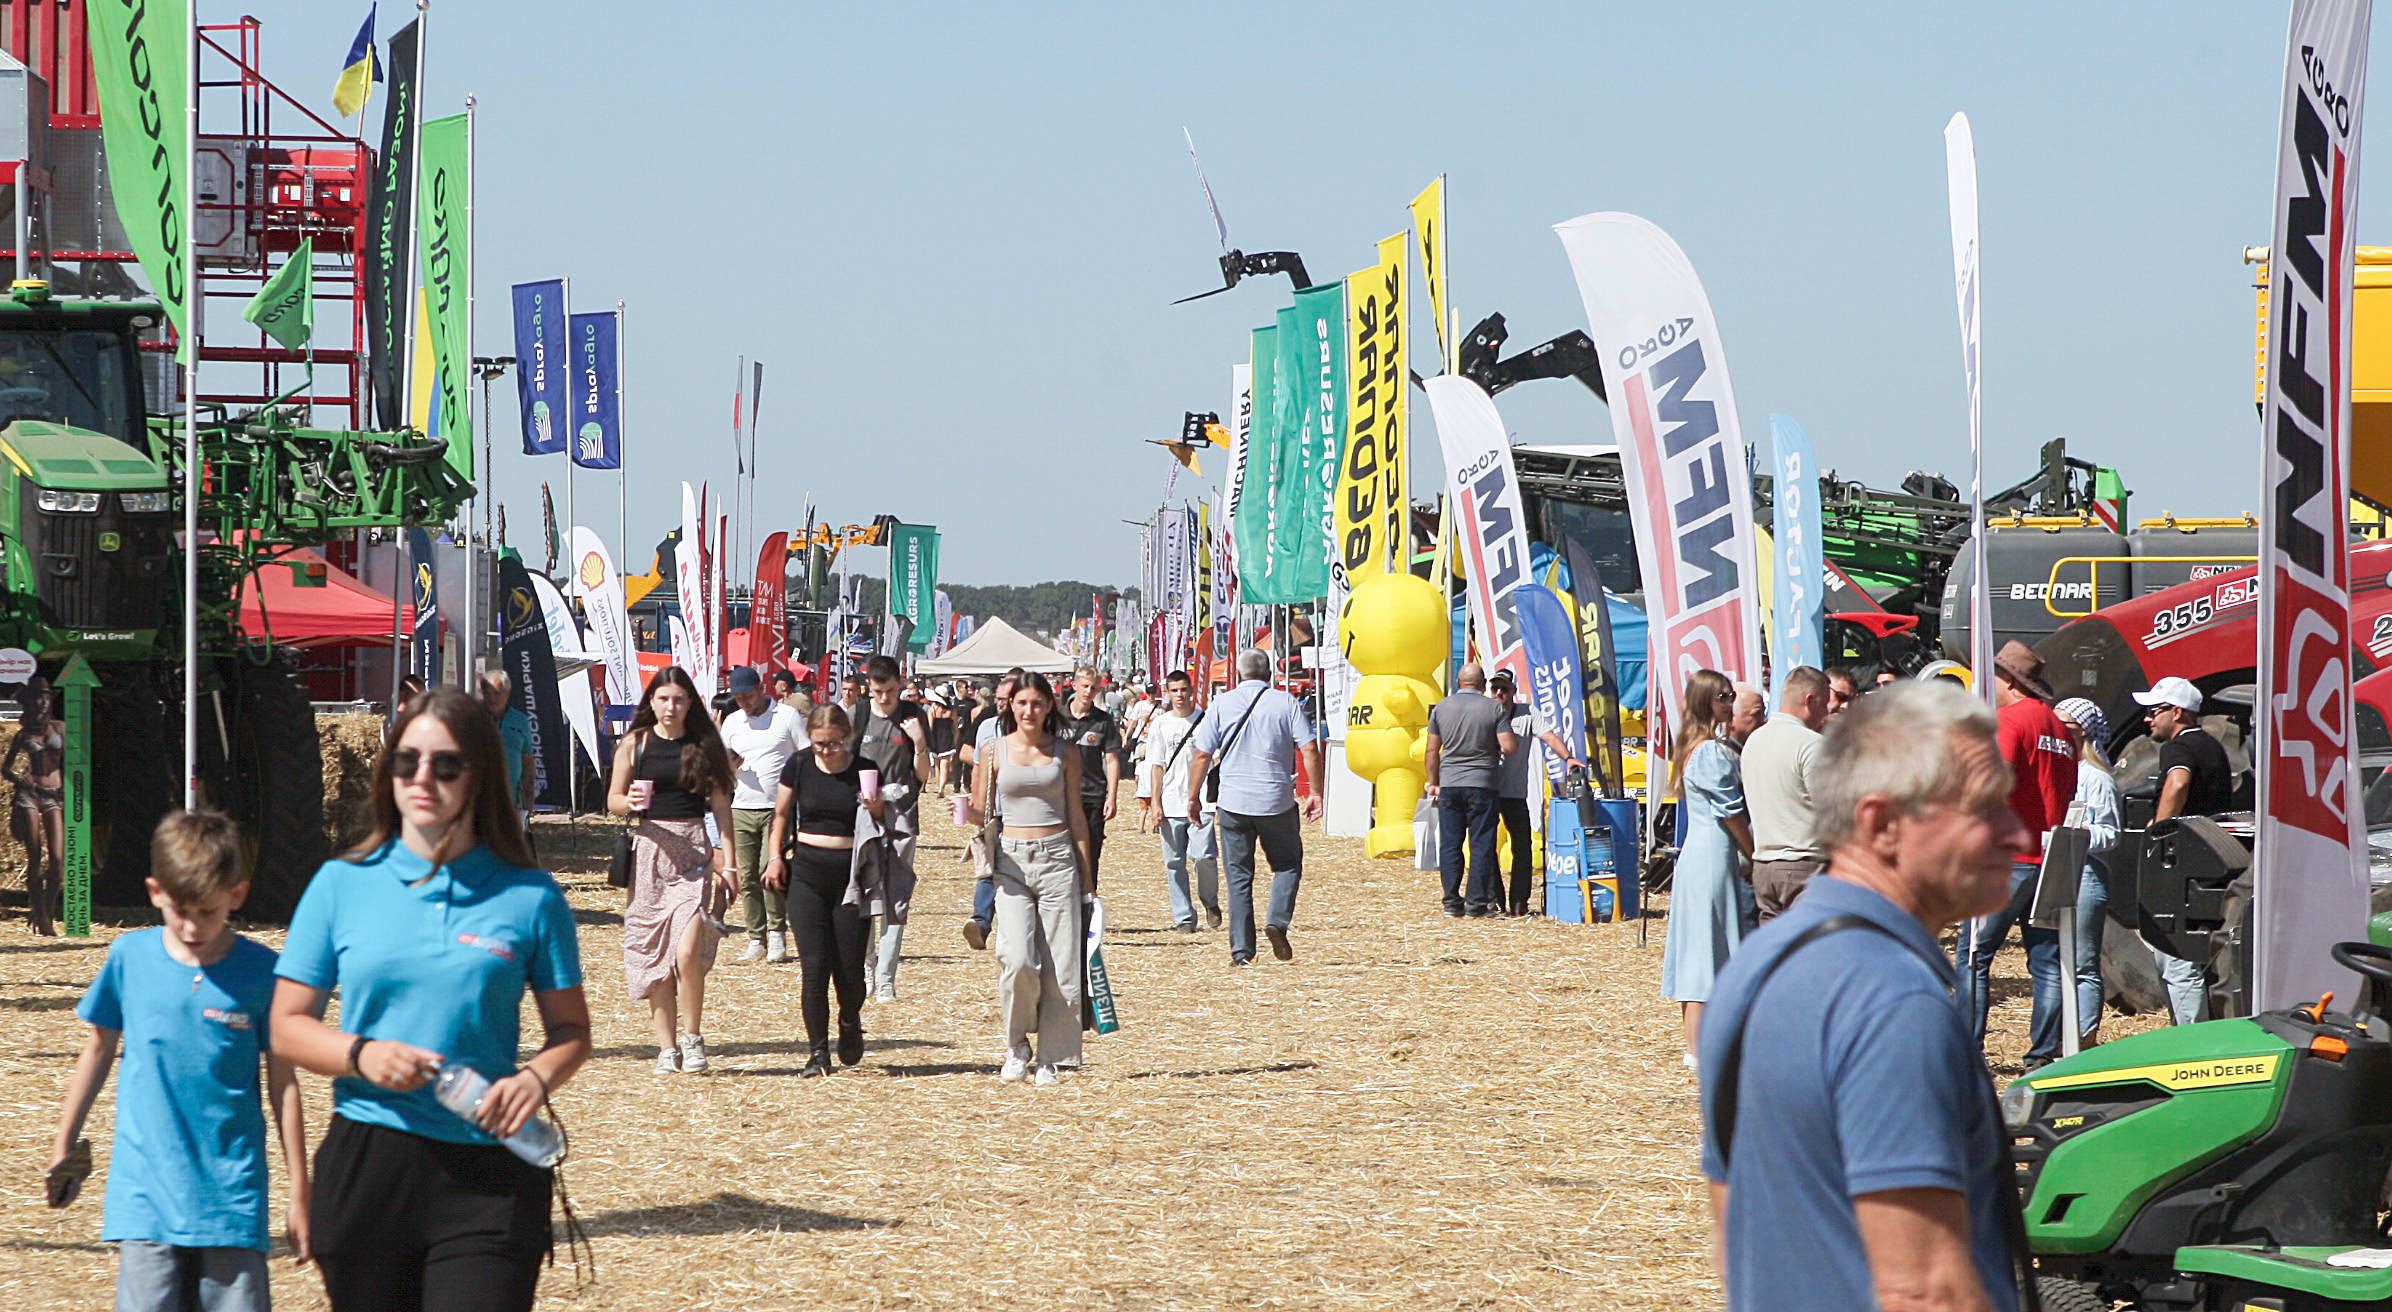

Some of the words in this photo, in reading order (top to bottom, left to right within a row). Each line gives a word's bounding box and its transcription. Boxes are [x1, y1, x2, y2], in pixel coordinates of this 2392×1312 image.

[2301, 44, 2350, 139] AGRO
[2275, 83, 2330, 580] NFM
[908, 536, 919, 626] AGRORESURS
[2010, 582, 2093, 601] BEDNAR
[2153, 595, 2213, 637] 355
[521, 651, 548, 789] ЗЕРНОСУШАРКИ
[67, 826, 76, 867] РАЗОМ!
[79, 852, 88, 888] ДНЕМ.
[67, 869, 76, 935] ЗРОСТАЄМО
[79, 889, 87, 904] ЗА
[79, 906, 88, 935] ДЕНЬ
[1090, 962, 1114, 1025] ЛІЗИНГ
[2171, 1067, 2210, 1081] JOHN
[2214, 1063, 2265, 1077] DEERE
